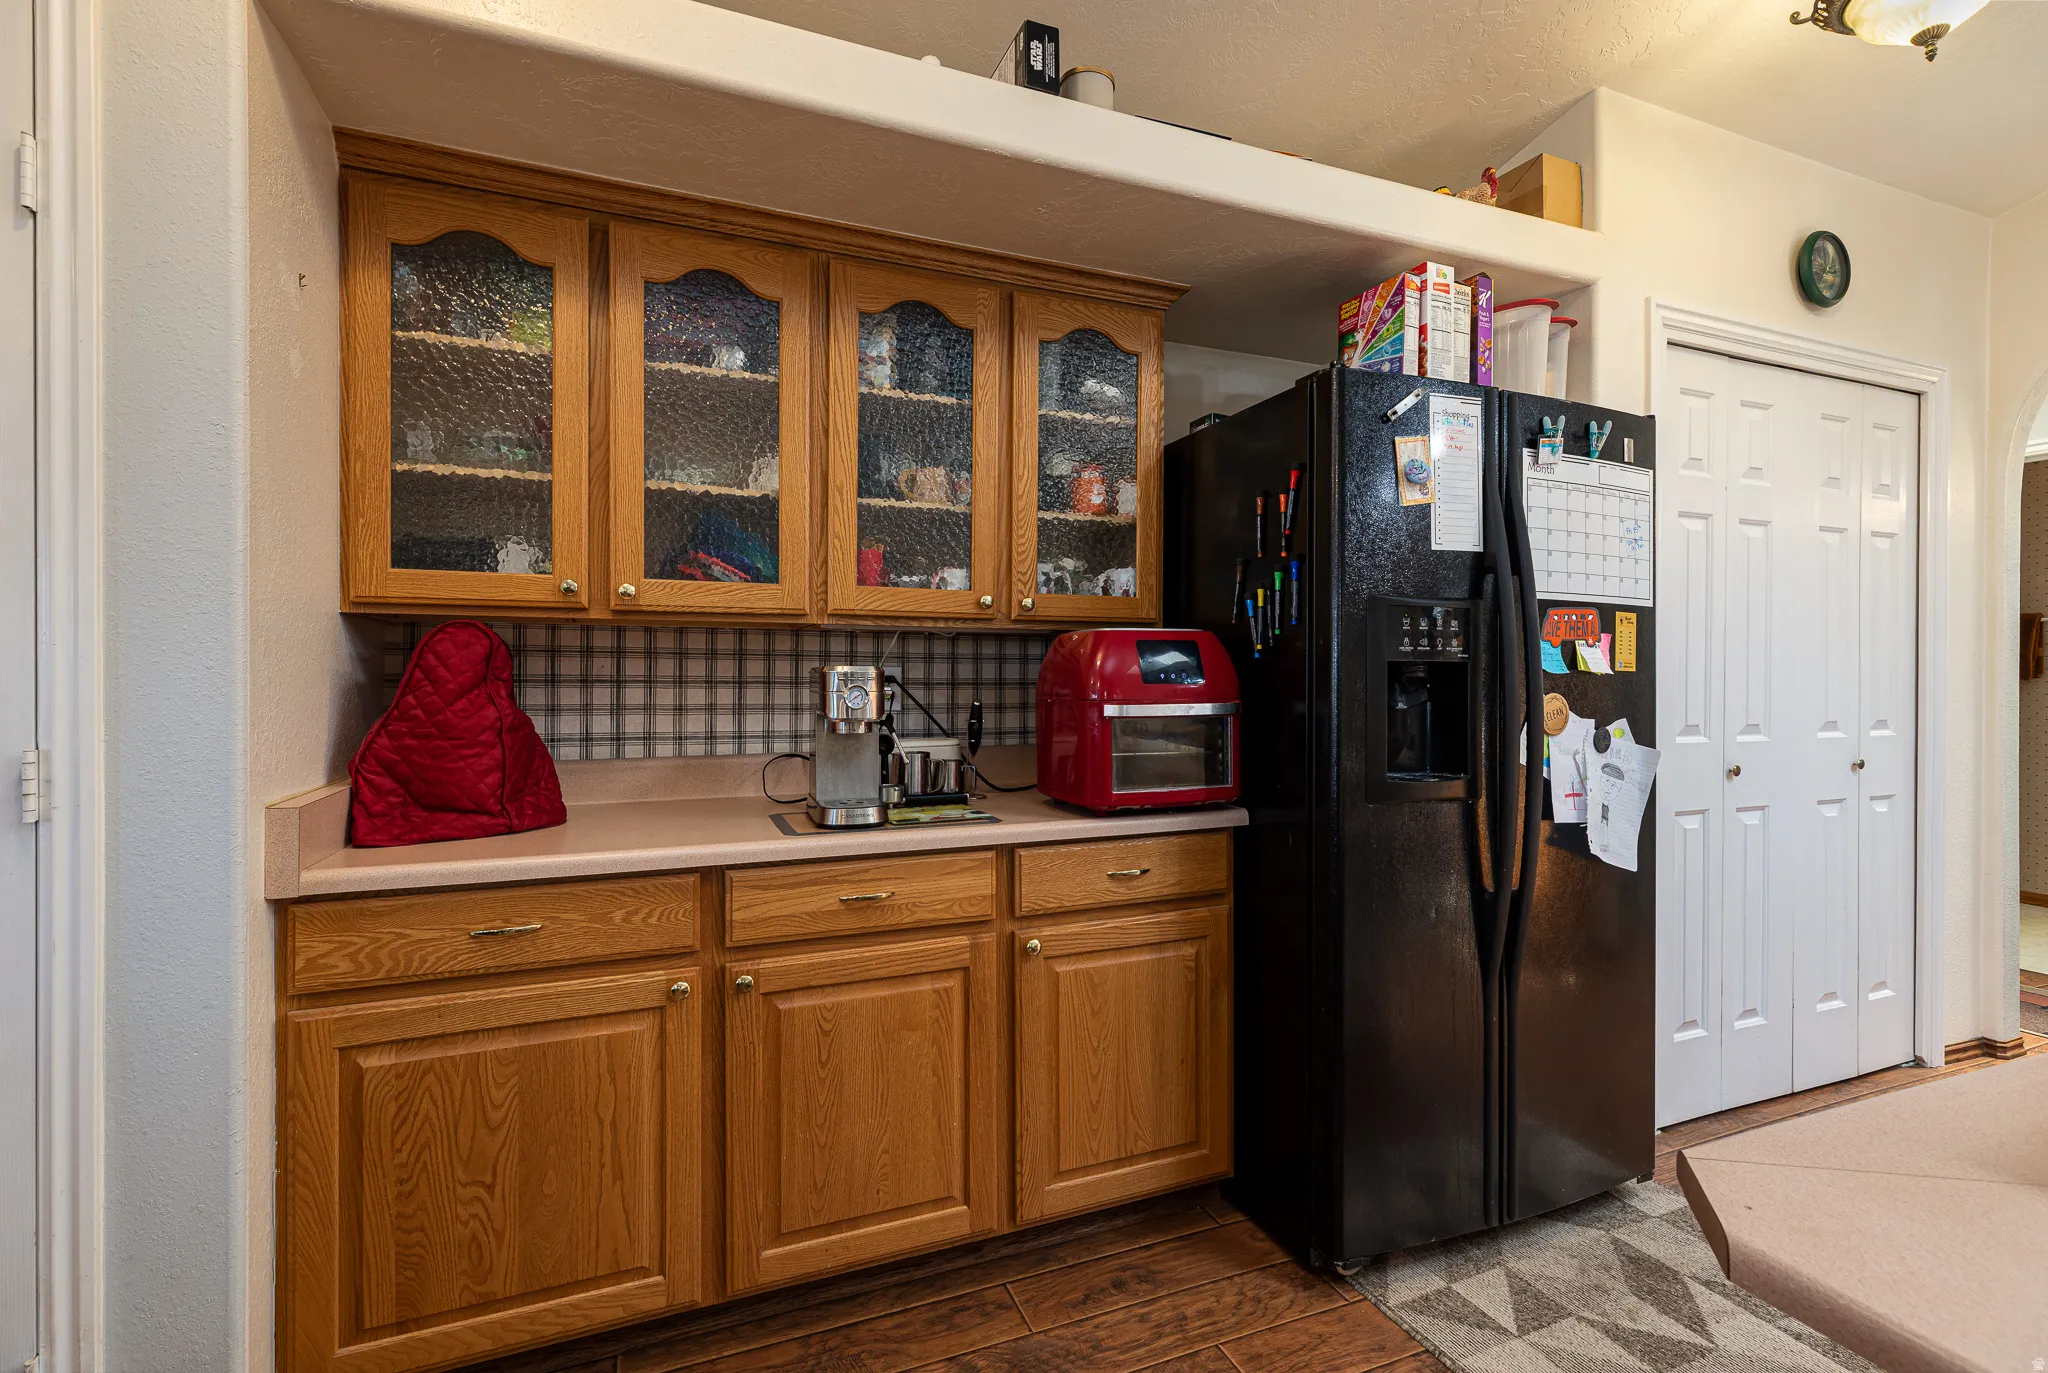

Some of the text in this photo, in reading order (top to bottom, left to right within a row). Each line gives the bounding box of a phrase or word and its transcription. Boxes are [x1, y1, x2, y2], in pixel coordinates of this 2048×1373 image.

[1030, 40, 1038, 65] STAR
[1034, 42, 1043, 70] WARS
[1442, 409, 1470, 421] Shopping
[1527, 462, 1555, 475] Month
[1564, 621, 1588, 638] THEM
[1545, 707, 1564, 722] CLEAN
